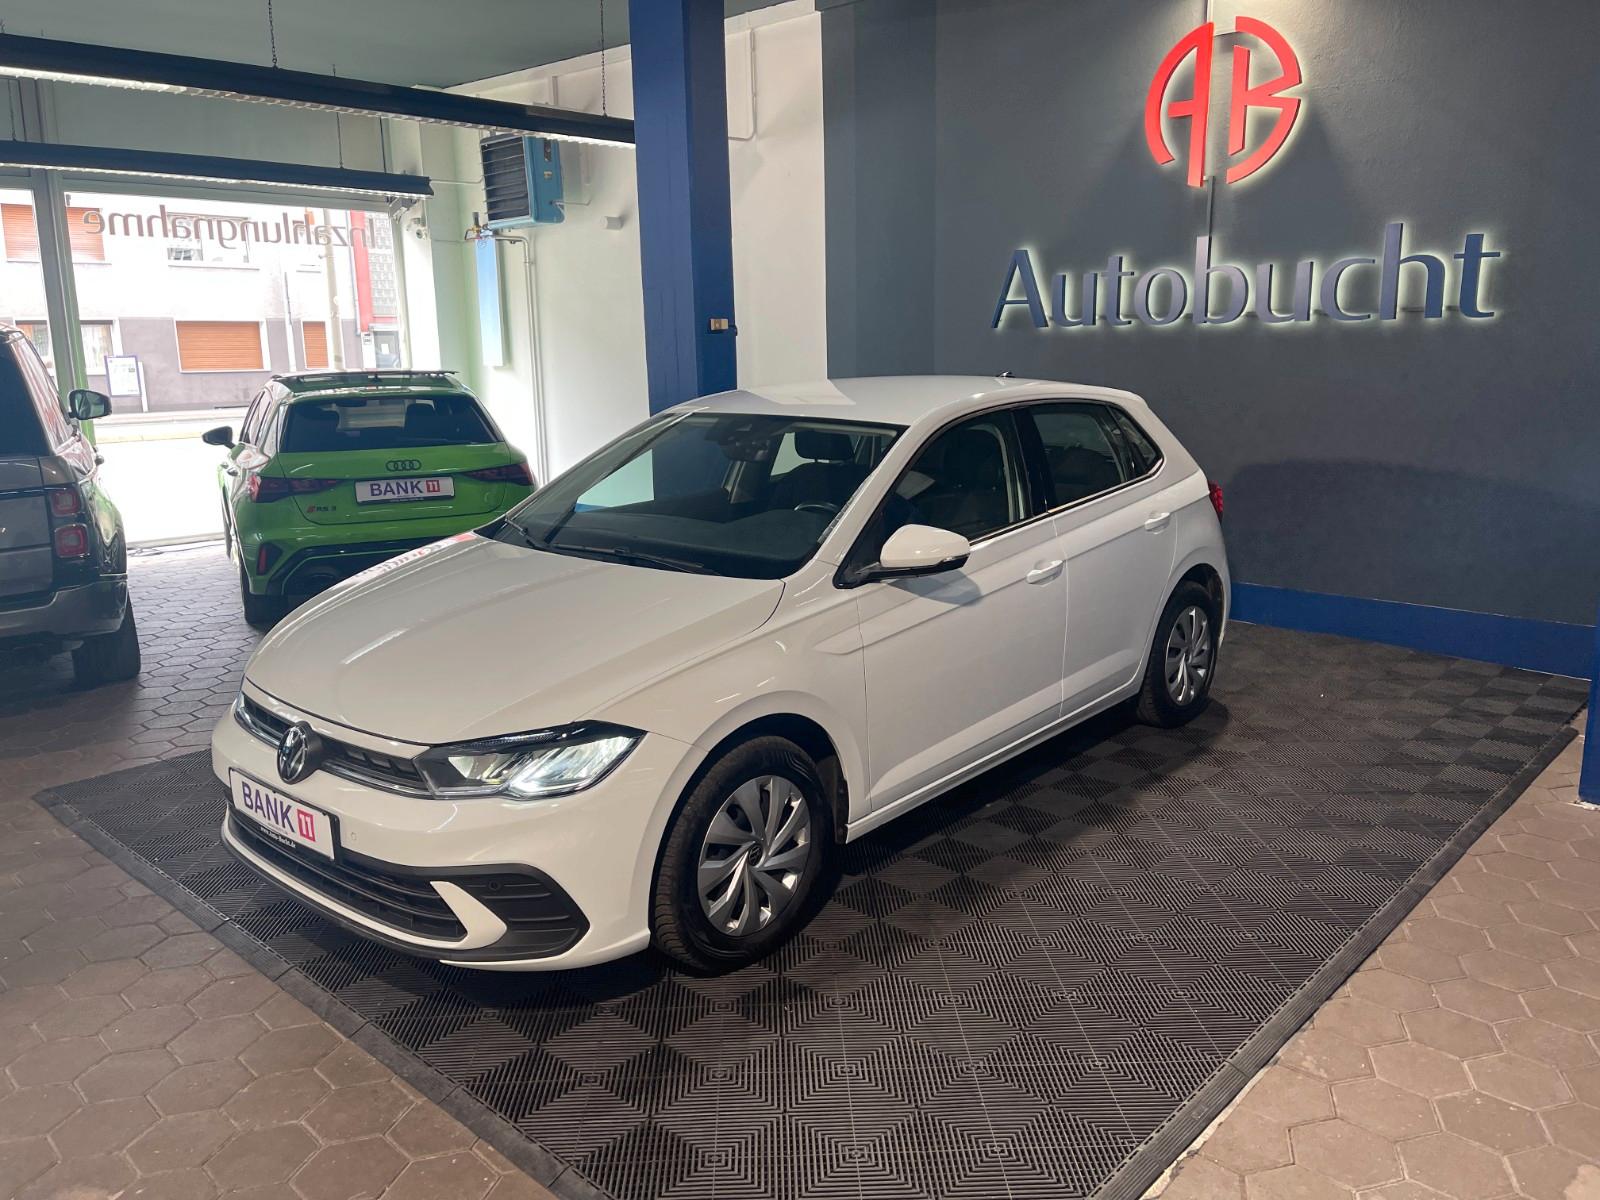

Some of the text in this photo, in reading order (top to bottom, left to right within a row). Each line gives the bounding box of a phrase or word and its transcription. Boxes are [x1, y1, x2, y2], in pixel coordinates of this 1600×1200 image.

[991, 223, 1500, 328] Autobucht
[370, 480, 439, 496] BANK 11
[242, 781, 315, 840] BANK 11
